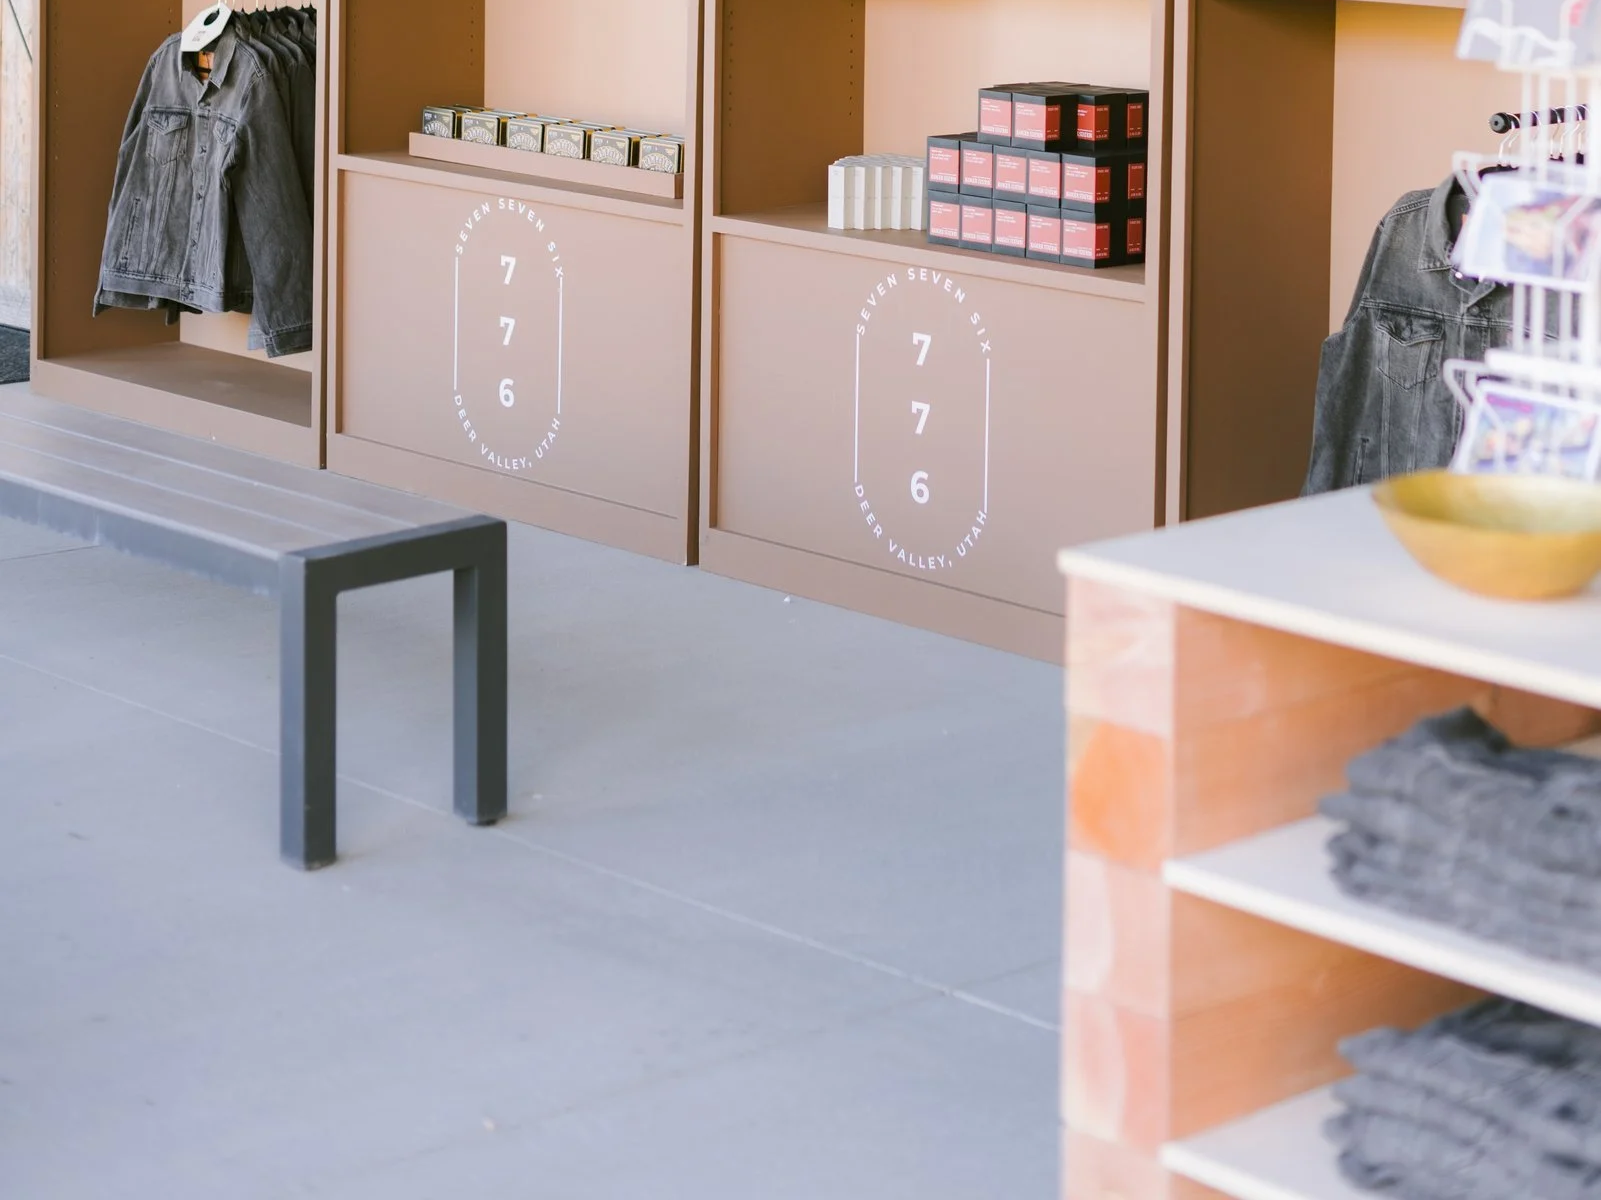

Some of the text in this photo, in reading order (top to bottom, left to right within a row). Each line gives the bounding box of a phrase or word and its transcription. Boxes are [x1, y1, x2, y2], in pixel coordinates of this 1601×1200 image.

[455, 197, 564, 278] SEVEN SEVEN SIX
[500, 254, 516, 285] 7
[856, 267, 992, 354] SEVEN SEVEN SIX
[499, 315, 516, 346] 7
[912, 331, 932, 366] 7
[498, 377, 515, 408] 6
[454, 394, 561, 470] DEER VALLEY, UTAH
[911, 400, 931, 435] 7
[910, 470, 930, 504] 6
[854, 484, 987, 570] DEER VALLEY, UTAH
